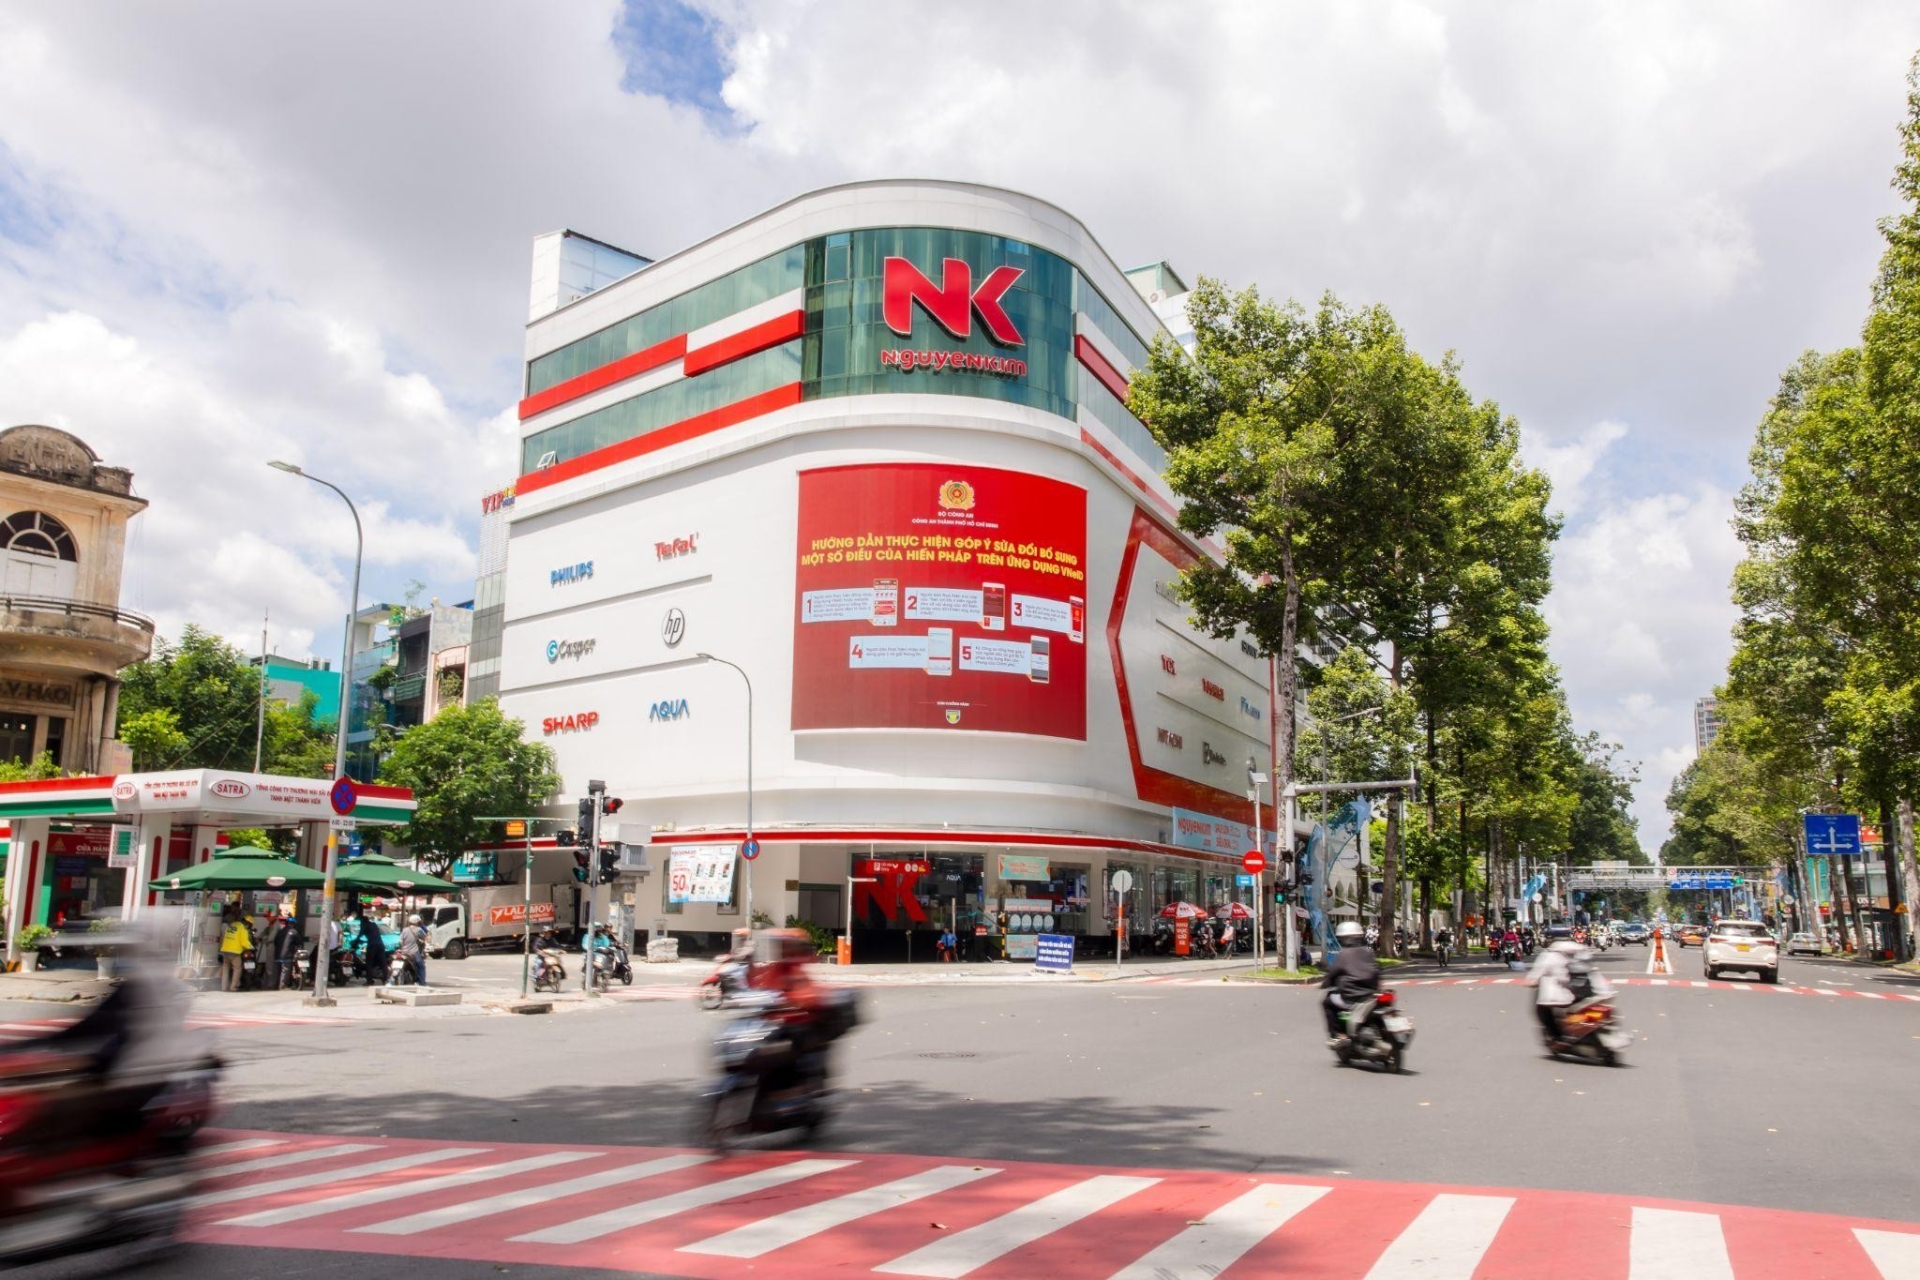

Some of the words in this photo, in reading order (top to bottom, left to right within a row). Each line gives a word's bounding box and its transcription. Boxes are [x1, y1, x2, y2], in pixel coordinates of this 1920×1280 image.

[883, 257, 1026, 346] NK
[655, 534, 698, 558] Tefal
[857, 532, 883, 547] DẪN
[886, 535, 919, 548] THỰC
[922, 535, 951, 550] HIỆN
[954, 537, 982, 549] GÓP
[984, 538, 992, 550] Ý
[994, 540, 1016, 554] SỬA
[1054, 552, 1078, 566] SUNG
[551, 561, 594, 586] PHILIPS
[802, 553, 824, 566] MỘT
[827, 550, 844, 562] SỐ
[876, 547, 902, 561] CỦA
[906, 548, 934, 561] HIẾN
[938, 550, 972, 563] PHÁP
[976, 552, 1004, 566] TRÊN
[1007, 555, 1030, 570] ỨNG
[1033, 560, 1060, 574] DỤNG
[1060, 566, 1084, 580] VNeID
[807, 599, 812, 613] 1
[908, 596, 917, 610] 2
[1014, 602, 1022, 616] 3
[560, 639, 596, 660] Casper
[852, 644, 863, 658] 4
[962, 646, 972, 660] 5
[650, 698, 690, 720] AQUA
[543, 711, 599, 735] SHARP
[116, 787, 132, 796] SATRA
[217, 784, 244, 794] SATRA
